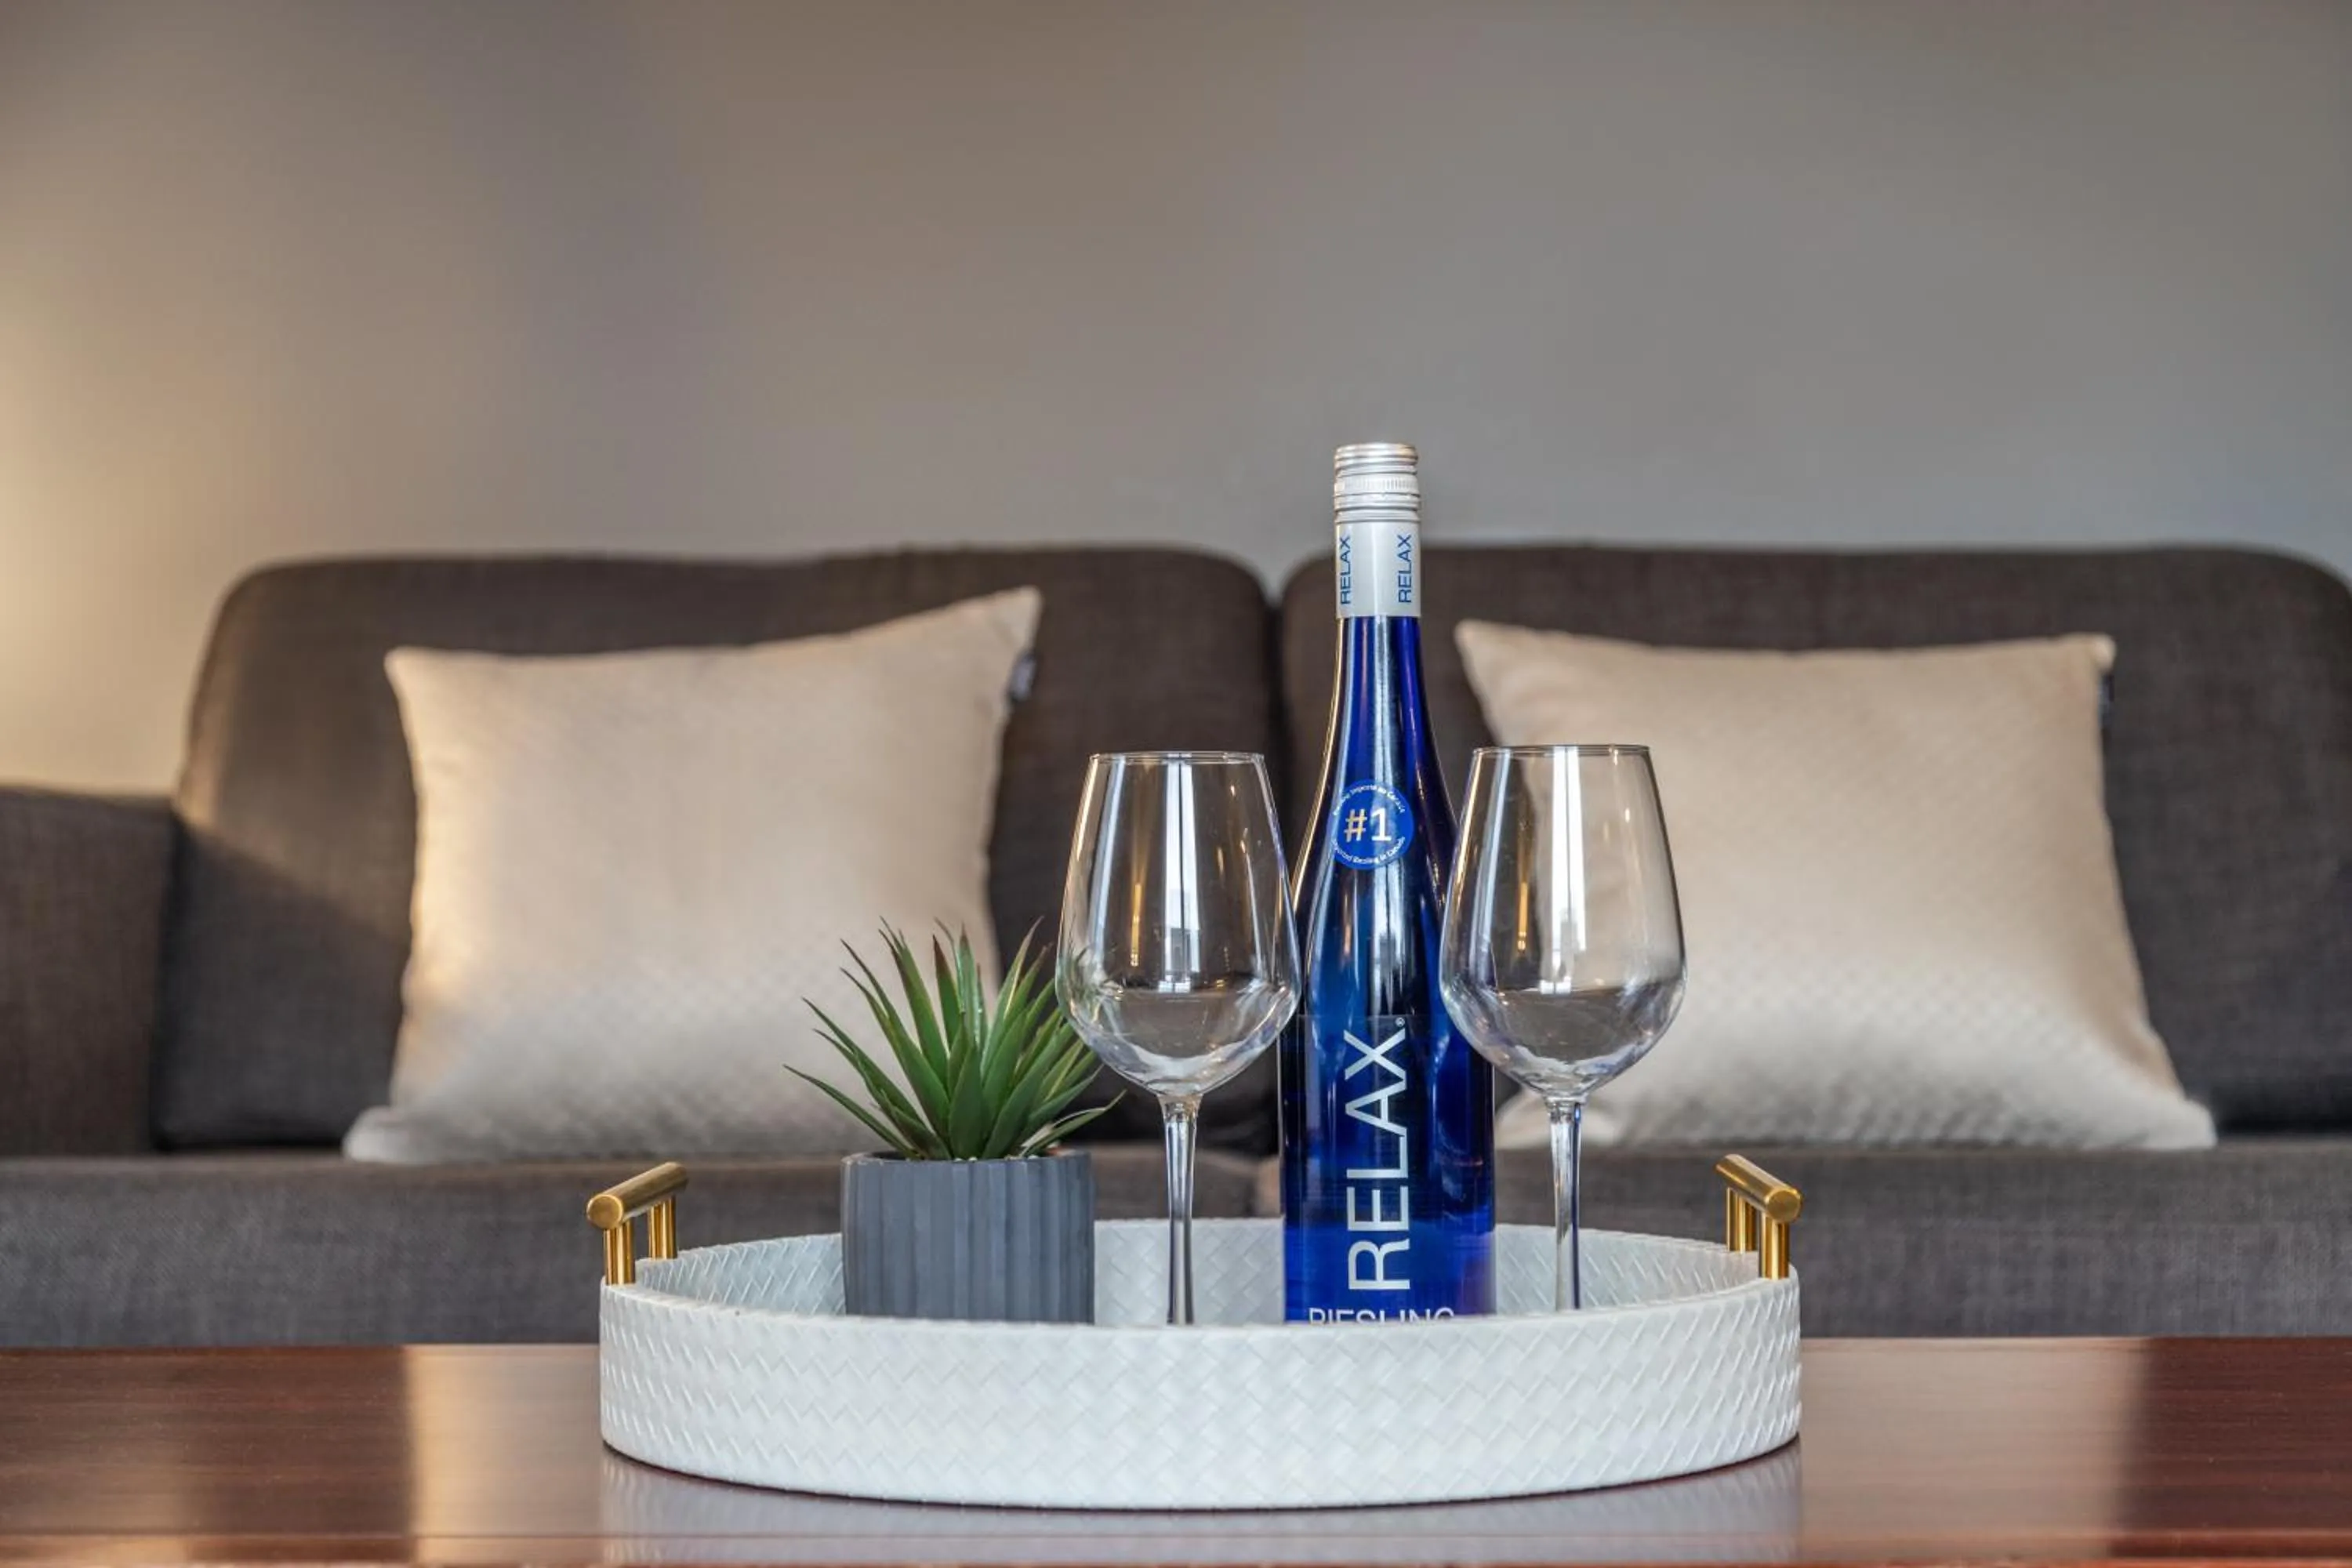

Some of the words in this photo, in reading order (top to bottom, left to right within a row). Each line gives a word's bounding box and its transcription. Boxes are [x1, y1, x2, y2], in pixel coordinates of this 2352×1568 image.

[1340, 535, 1351, 604] RELAX
[1397, 534, 1412, 603] RELAX
[1344, 808, 1392, 843] #1
